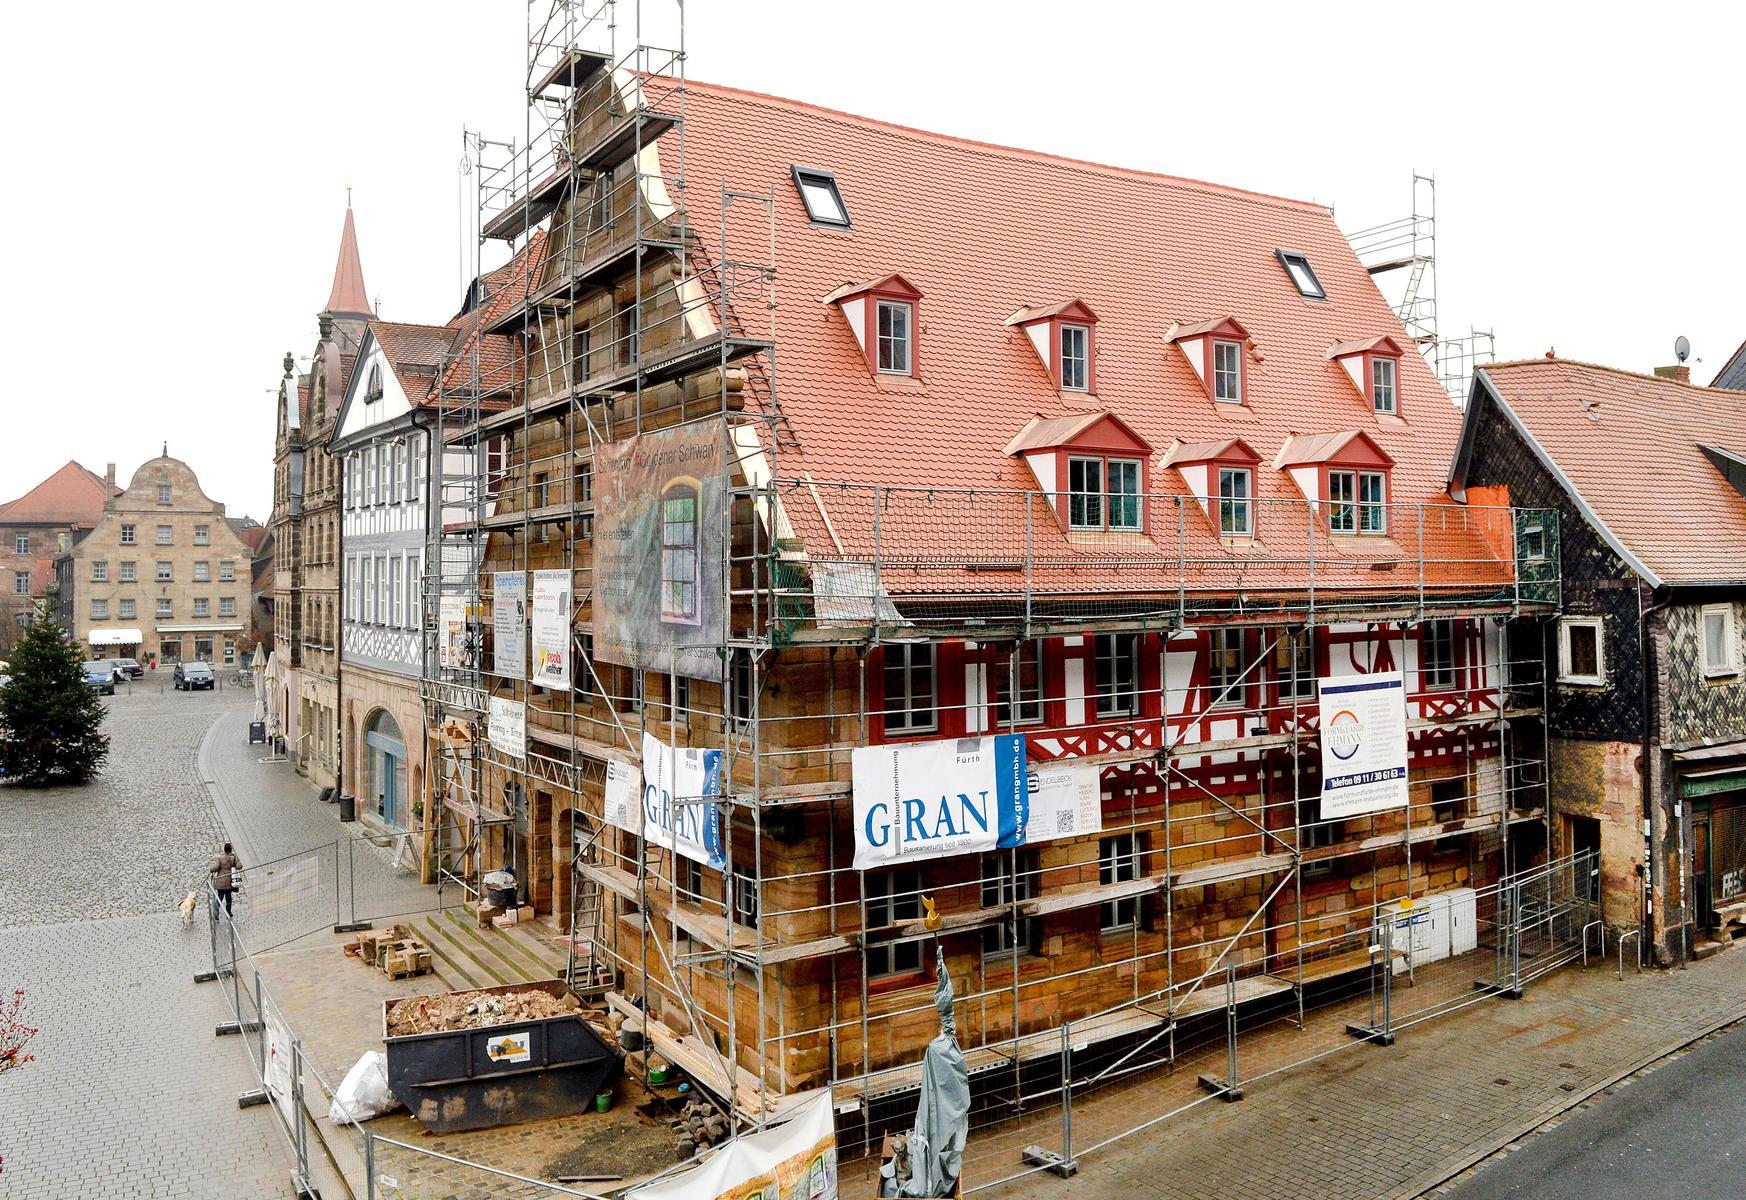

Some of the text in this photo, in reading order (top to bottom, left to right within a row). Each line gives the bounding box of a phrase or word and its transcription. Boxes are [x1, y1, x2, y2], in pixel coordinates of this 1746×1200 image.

[893, 750, 901, 825] Bauunternehmung
[956, 755, 981, 765] Fürth
[1330, 776, 1353, 788] Telefon
[1353, 775, 1362, 784] 09
[1362, 773, 1370, 783] 11
[865, 790, 989, 848] GRAN
[1012, 738, 1022, 842] www.grangmbh.de
